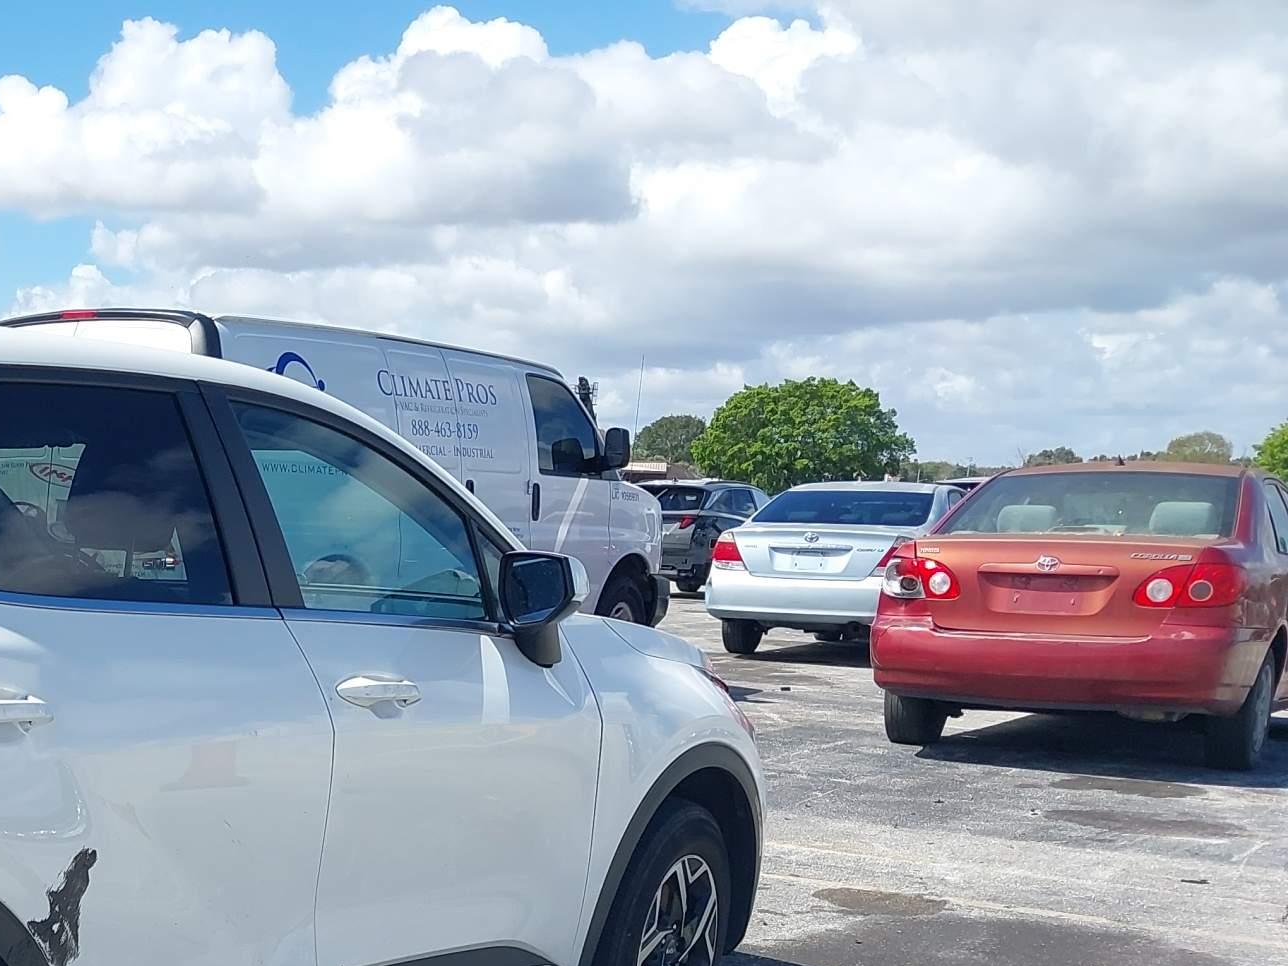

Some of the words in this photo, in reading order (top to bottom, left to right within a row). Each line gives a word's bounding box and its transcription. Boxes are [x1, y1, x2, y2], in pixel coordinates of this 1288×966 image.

[377, 369, 453, 401] CLIMATE
[455, 378, 497, 406] PROS
[411, 419, 479, 440] 888-463-8159
[453, 446, 494, 459] INDUSTRIAL
